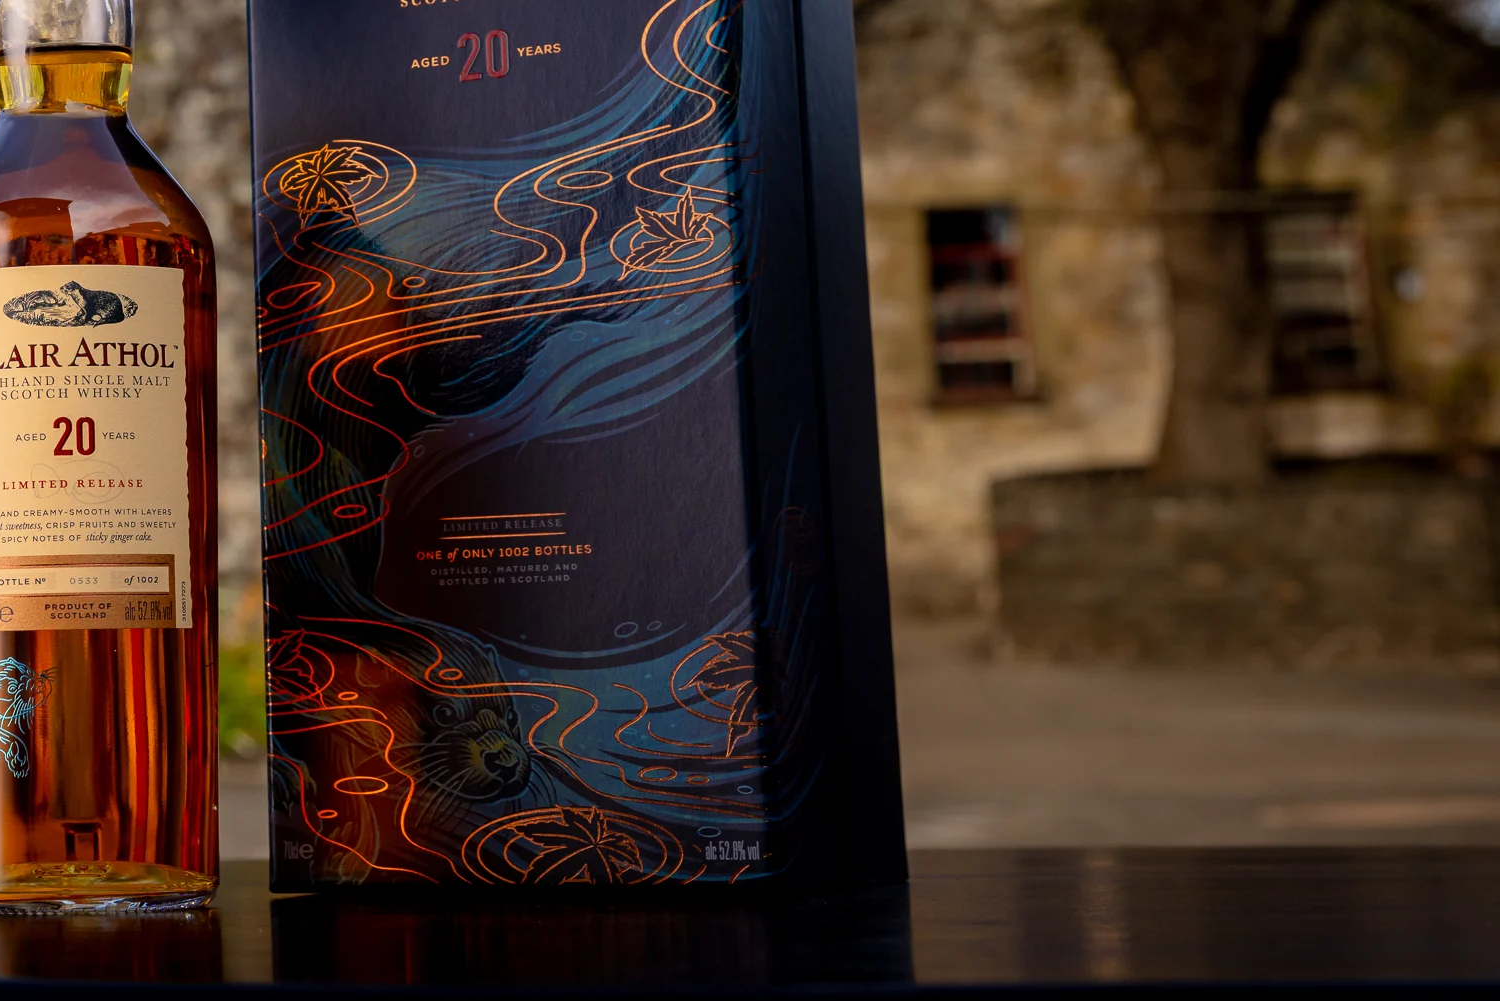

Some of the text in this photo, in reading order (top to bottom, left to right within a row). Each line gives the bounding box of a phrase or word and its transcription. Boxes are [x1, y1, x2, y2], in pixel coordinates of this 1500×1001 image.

[411, 28, 562, 83] AGED 20 YEARS
[63, 374, 125, 386] SINGLE
[132, 375, 171, 387] MALT
[0, 387, 143, 400] SCOTCH WHISKY
[15, 416, 136, 456] AGED 20 YEARS
[2, 479, 143, 490] LIMITED RELEASE
[0, 510, 20, 518] AND
[23, 508, 111, 517] CREAMY-SMOOTH
[113, 508, 138, 516] WITH
[141, 508, 173, 516] LAYERS
[4, 521, 43, 532] sweetness,
[45, 521, 76, 530] CRISP
[79, 521, 114, 529] FRUITS
[117, 520, 137, 529] AND
[139, 520, 177, 529] SWEETLY
[443, 518, 563, 533] LIMITED RELEASE
[1, 532, 153, 544] SPICY NOTES OF sticky ginger cake.
[416, 544, 593, 563] ONE of ONLY 1002 BOTTLES
[497, 563, 549, 573] MATURED
[554, 562, 579, 571] AND
[69, 577, 99, 585] 0533
[124, 575, 136, 584] of
[136, 576, 159, 584] 1002
[438, 574, 571, 586] BOTTLED IN SCOTLAND
[44, 602, 112, 611] PRODUCT OF
[124, 601, 173, 621] alc 52.8% vol
[50, 611, 107, 620] SCOTLAND
[705, 840, 760, 861] alc 52.8% vol
